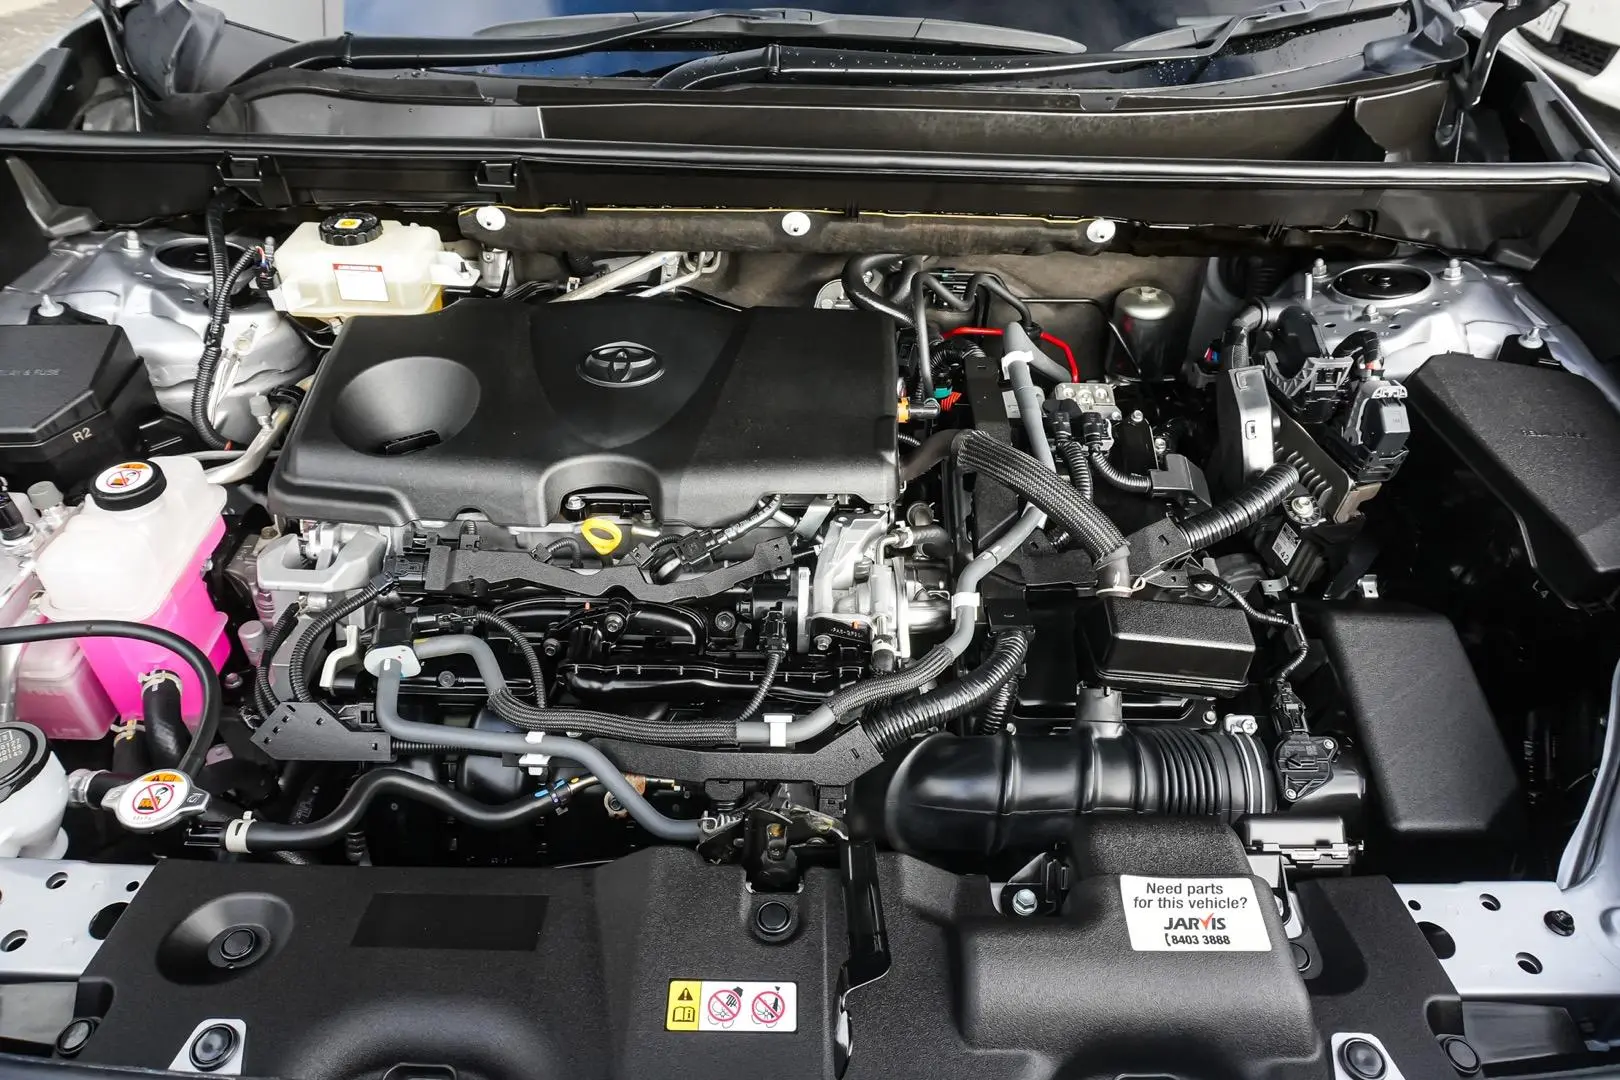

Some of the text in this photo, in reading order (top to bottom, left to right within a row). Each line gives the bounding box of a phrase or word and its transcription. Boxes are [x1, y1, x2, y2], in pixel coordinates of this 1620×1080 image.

[72, 427, 93, 443] R2
[1280, 551, 1290, 563] 42
[1146, 882, 1224, 897] Need parts
[1133, 896, 1248, 909] for this vehicle?
[1163, 912, 1227, 931] JARVIS
[1171, 934, 1231, 945] 8403 3888
